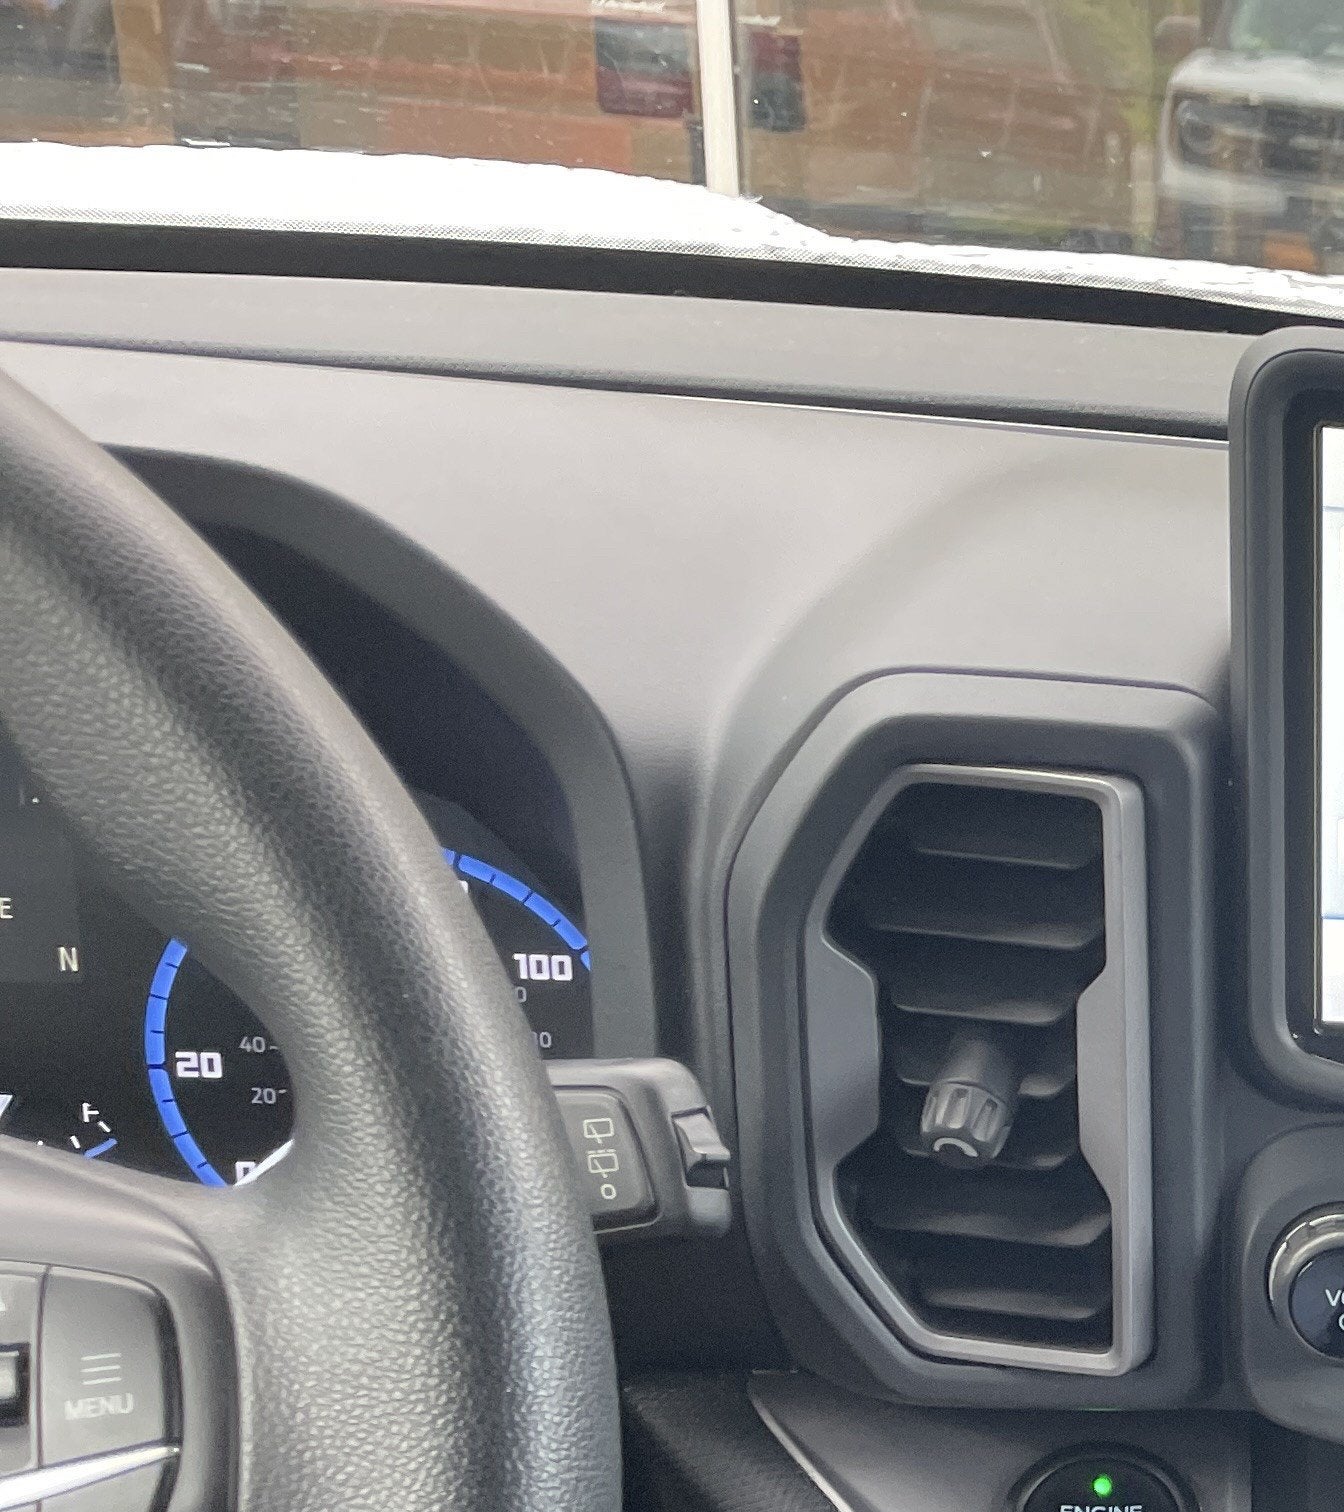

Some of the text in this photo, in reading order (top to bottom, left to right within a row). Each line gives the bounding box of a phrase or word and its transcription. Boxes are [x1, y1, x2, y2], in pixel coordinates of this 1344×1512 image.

[58, 946, 79, 972] N
[513, 953, 573, 981] 100
[239, 1036, 266, 1053] 40
[174, 1051, 223, 1079] 20
[251, 1087, 277, 1105] 20
[64, 1392, 134, 1420] MENU
